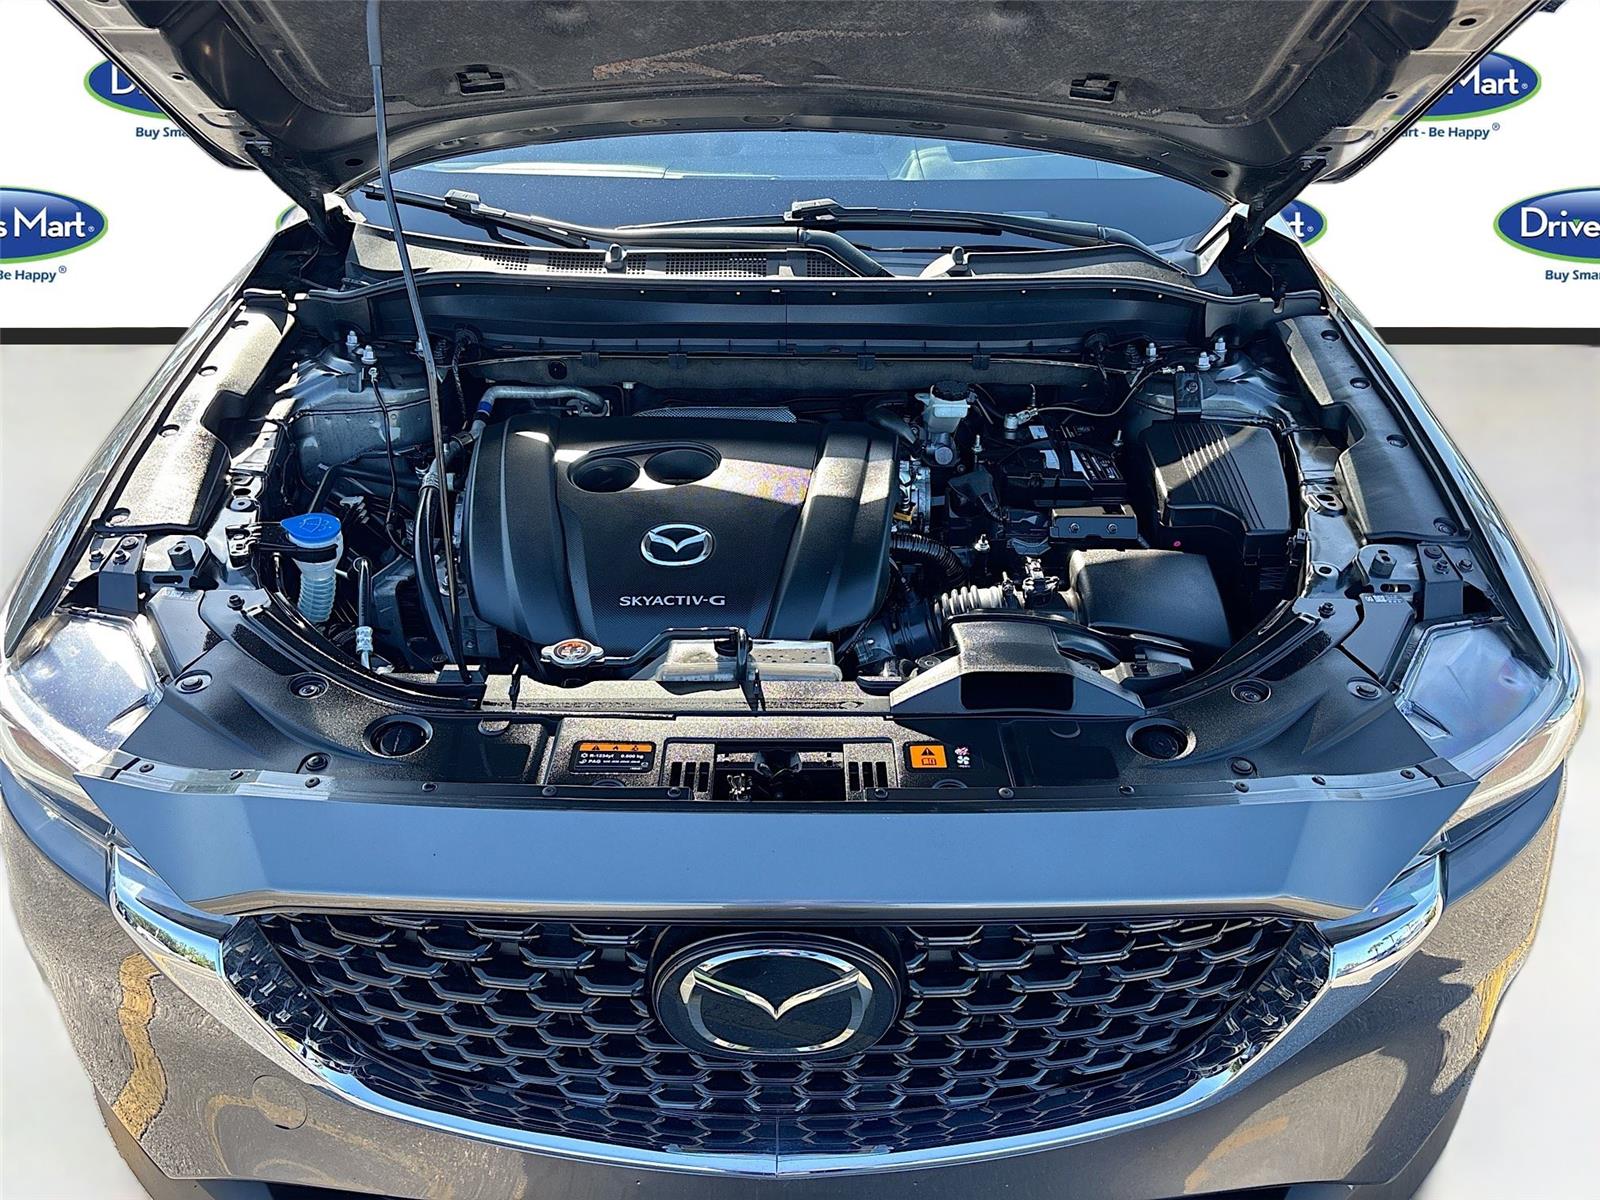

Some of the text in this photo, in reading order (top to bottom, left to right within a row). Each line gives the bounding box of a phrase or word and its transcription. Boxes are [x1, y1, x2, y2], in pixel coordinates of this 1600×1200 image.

[135, 127, 160, 140] Buy
[1428, 127, 1445, 137] Be
[1448, 127, 1490, 140] Happy
[14, 206, 86, 238] Mart
[15, 269, 57, 283] Happy
[1545, 269, 1600, 283] Buy Sma
[618, 594, 726, 607] SKYACTIV-G
